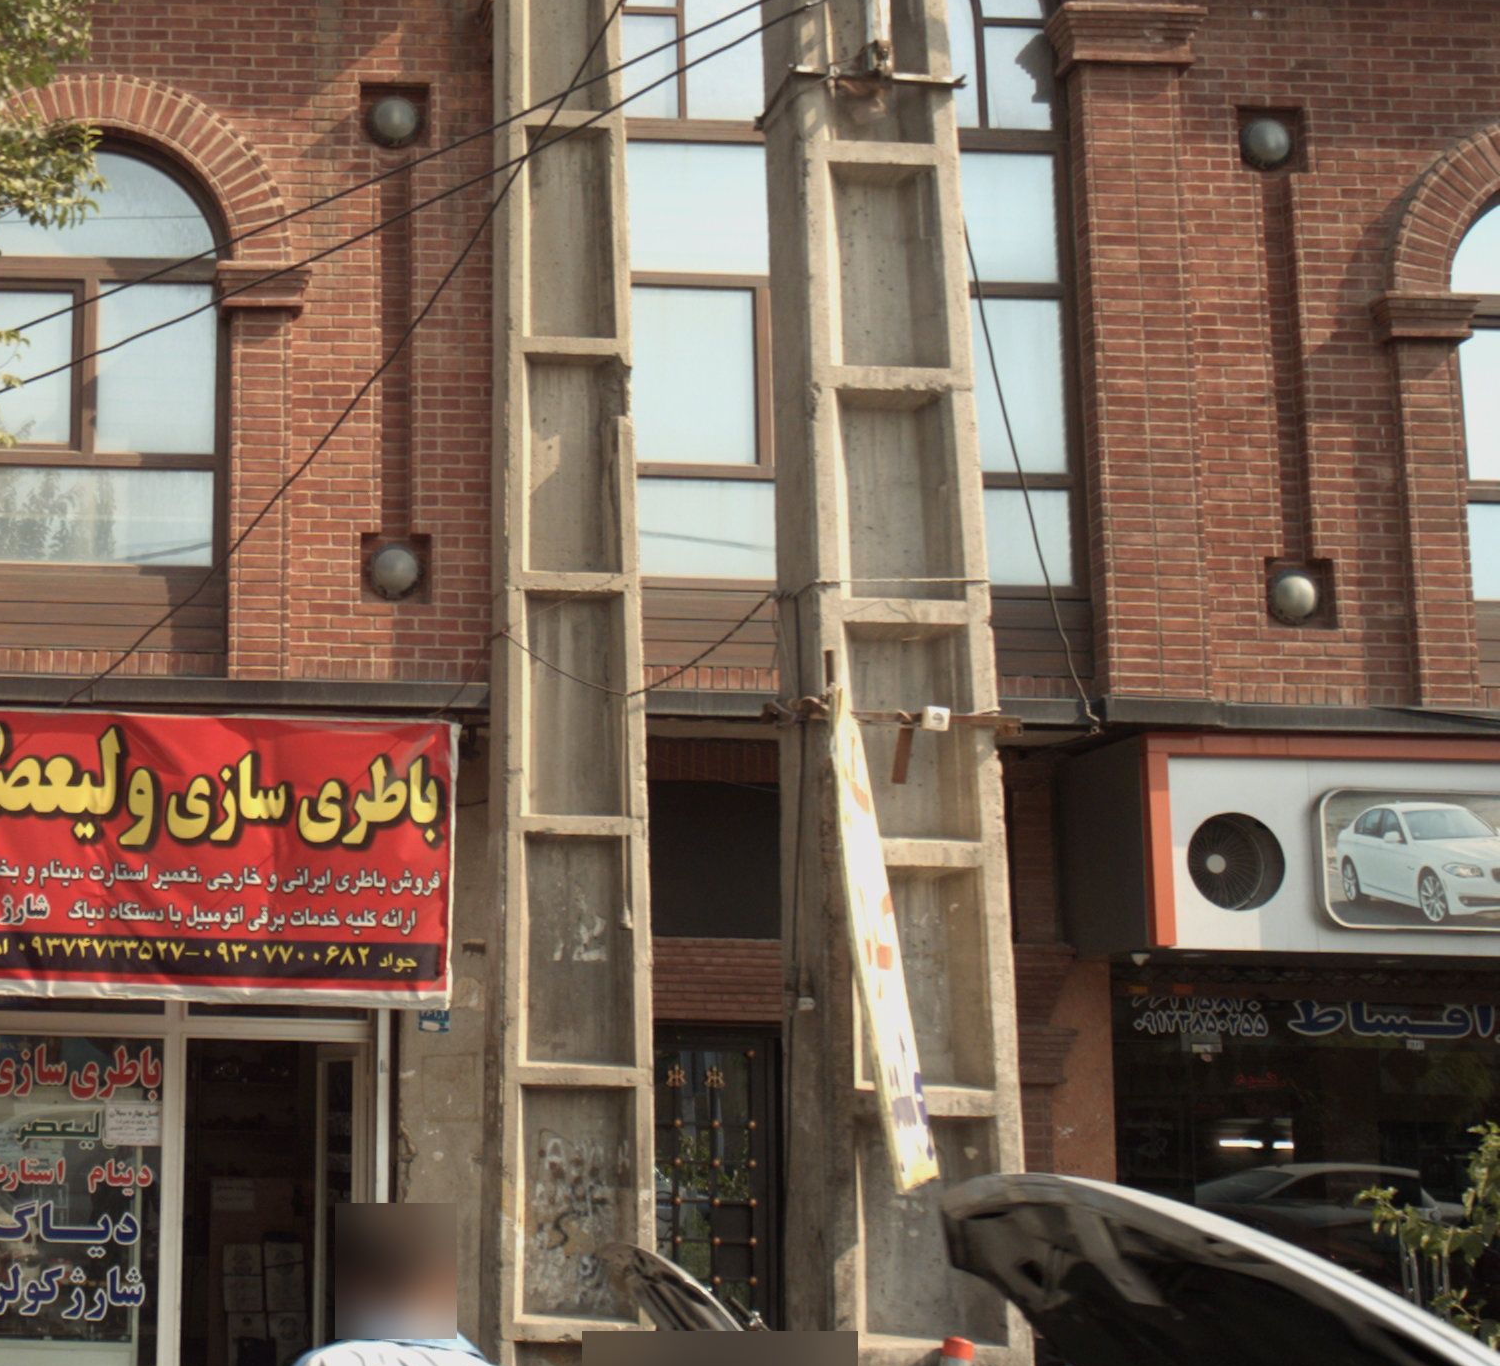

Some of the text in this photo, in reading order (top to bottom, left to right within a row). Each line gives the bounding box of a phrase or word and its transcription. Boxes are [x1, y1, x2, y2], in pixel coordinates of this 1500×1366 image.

[166, 752, 287, 842] سازی
[298, 753, 440, 845] باطری
[24, 866, 35, 885] و
[89, 863, 149, 887] استارت
[207, 867, 262, 892] خارجی
[266, 874, 278, 892] و
[282, 868, 331, 893] ایرانی
[335, 870, 387, 894] باطری
[391, 870, 442, 896] فروش
[0, 894, 51, 925] شارژ
[68, 899, 417, 934] ارائه کلیه خدمات برقی اتومبیل با دستگاه دیاگ
[379, 952, 418, 973] جواد
[69, 1045, 162, 1104] باطری
[87, 1158, 152, 1196] دینام
[61, 1265, 146, 1321] شارژ
